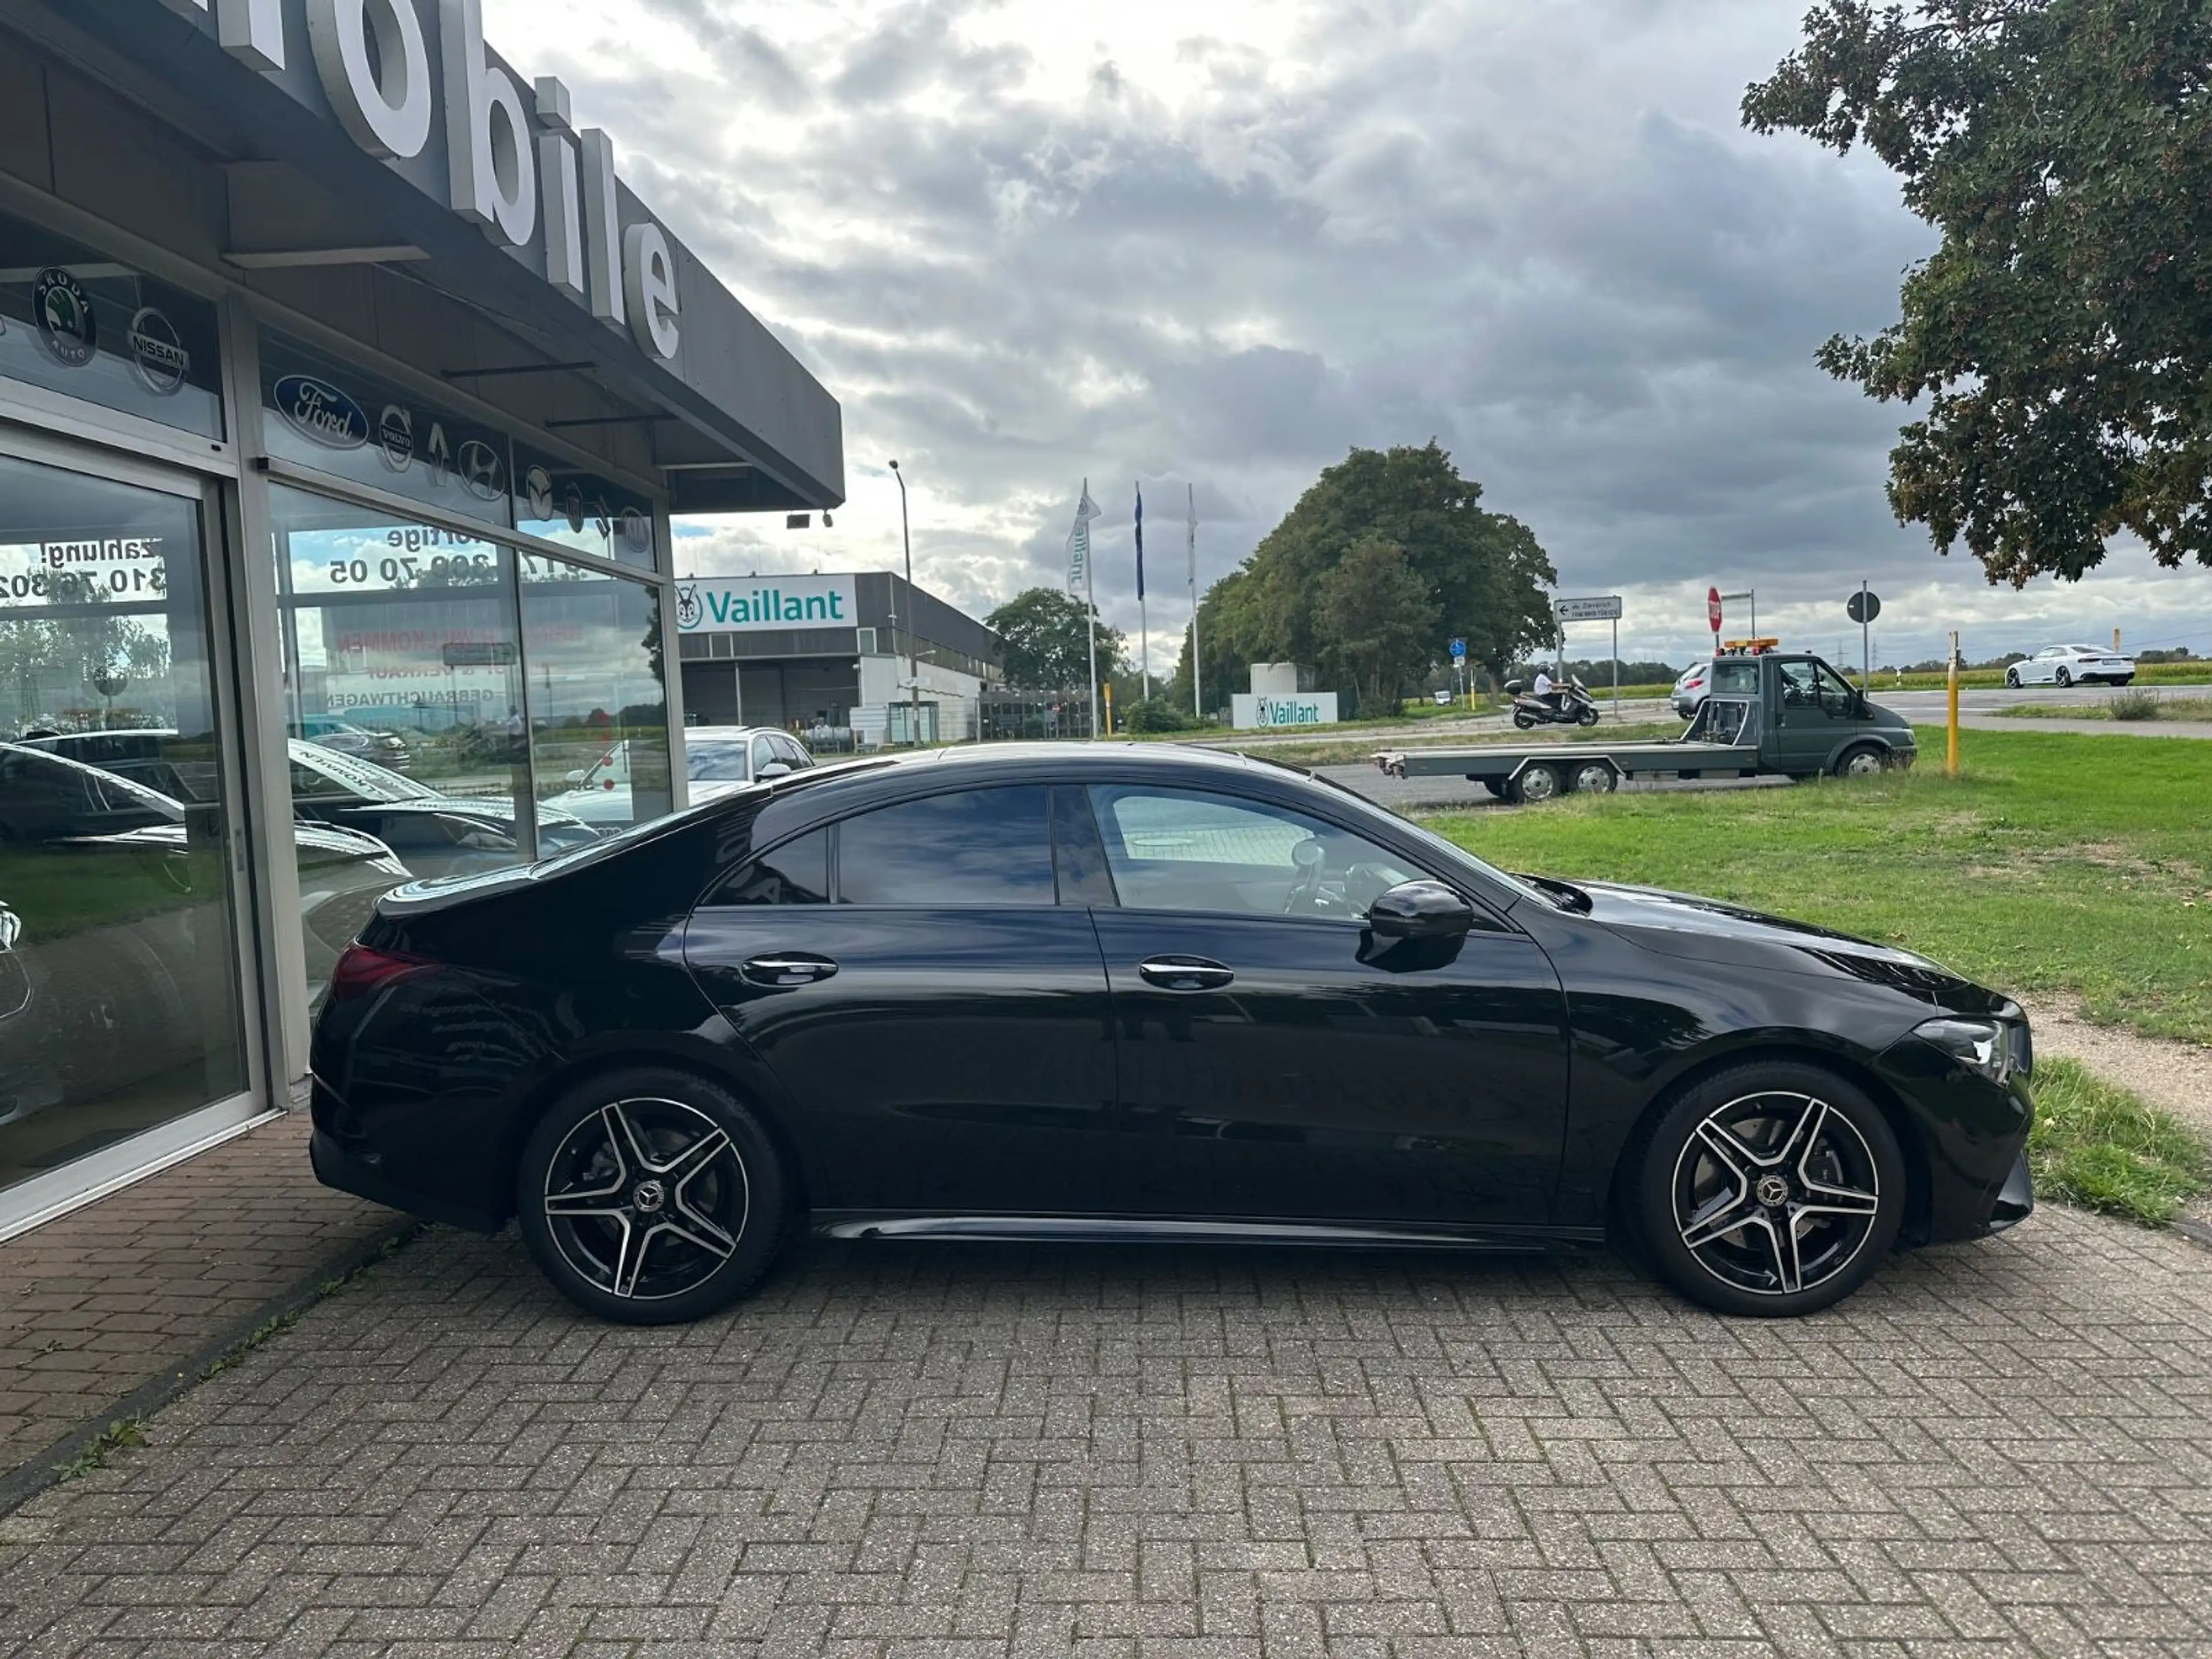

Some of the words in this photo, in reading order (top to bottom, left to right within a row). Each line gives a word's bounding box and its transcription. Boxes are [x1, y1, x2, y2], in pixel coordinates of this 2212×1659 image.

[156, 0, 679, 359] obile
[52, 340, 85, 359] AUTO
[132, 335, 184, 367] NISSAN
[294, 382, 353, 440] Ford
[706, 589, 844, 623] Vaillant
[1269, 700, 1319, 724] Vaillant
